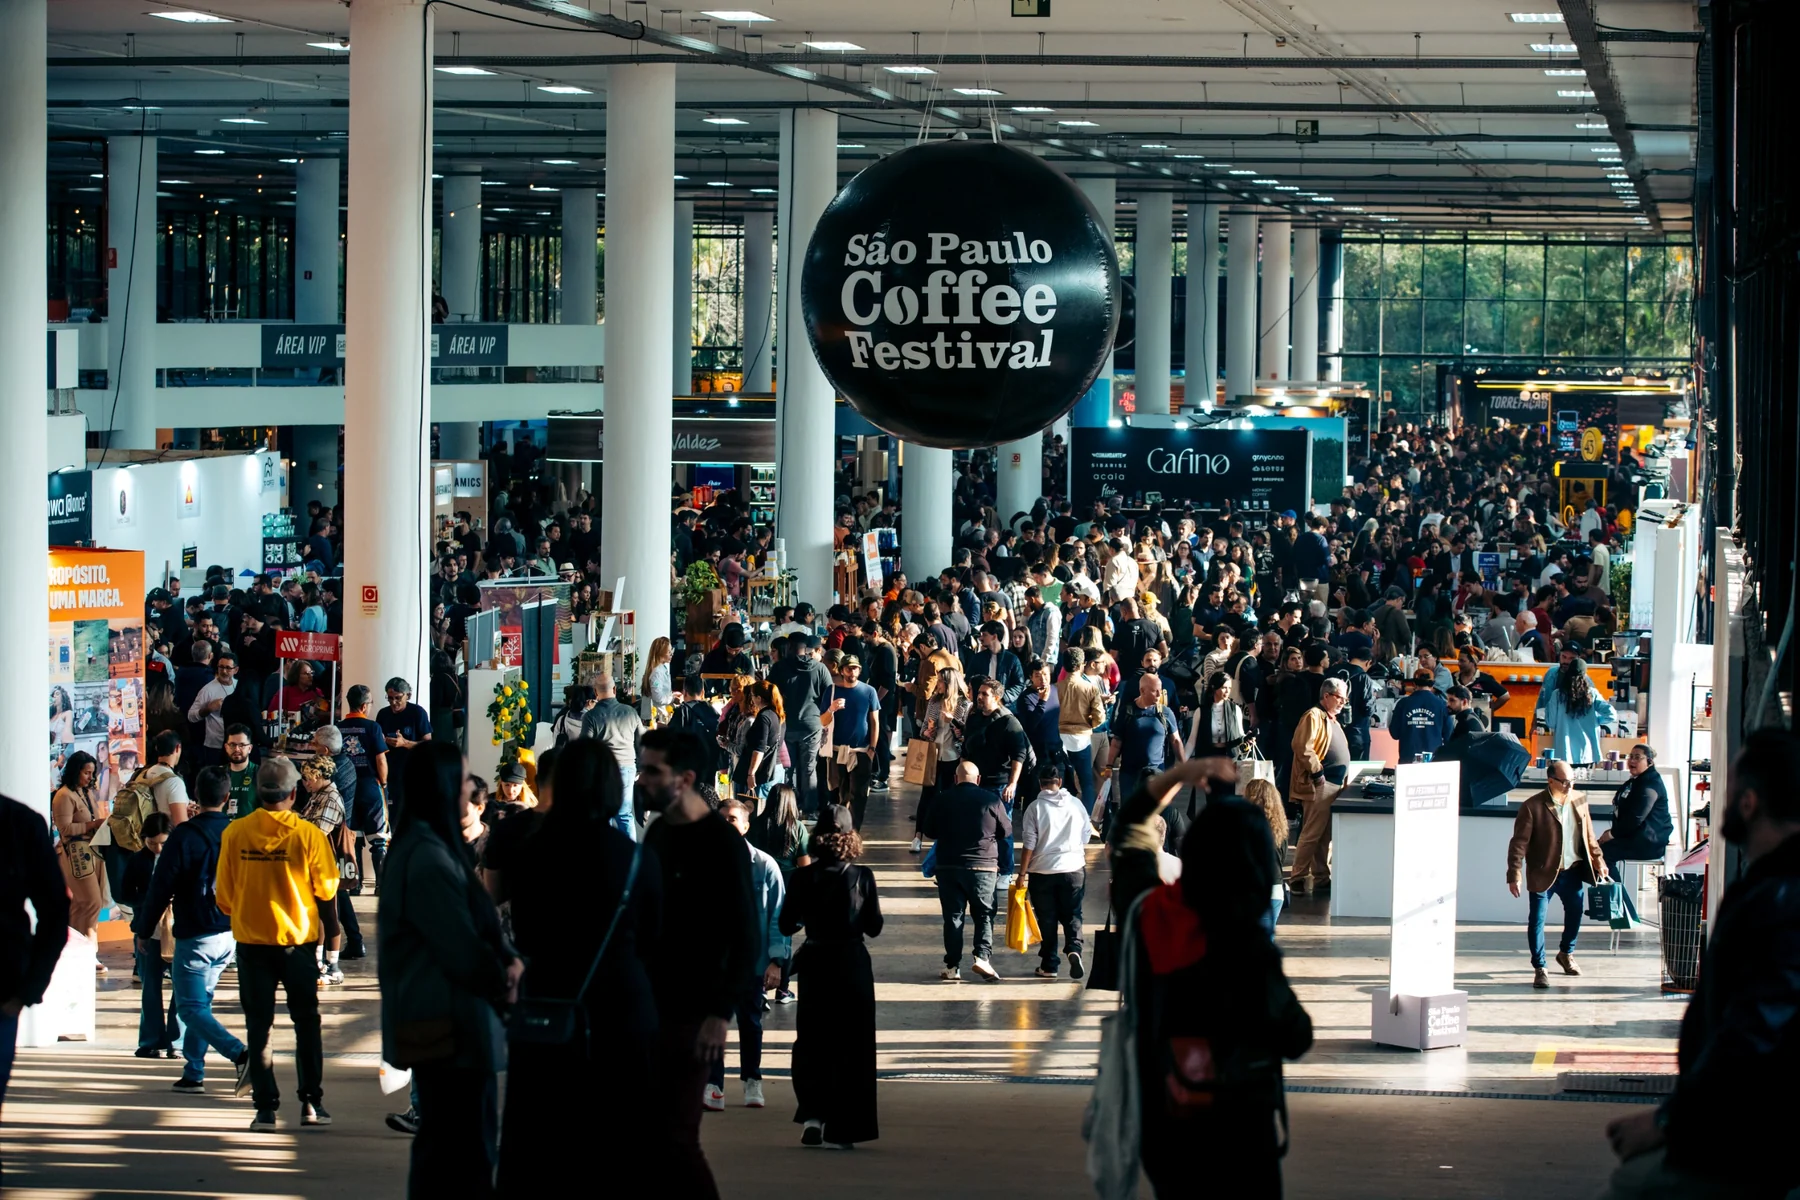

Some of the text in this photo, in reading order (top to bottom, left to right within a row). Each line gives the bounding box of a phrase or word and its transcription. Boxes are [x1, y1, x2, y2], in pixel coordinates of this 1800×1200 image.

[844, 232, 1053, 266] São Paulo
[841, 269, 1057, 326] Coffee
[276, 334, 305, 355] ÁREA
[308, 336, 327, 354] VIP
[449, 334, 476, 355] ÁREA
[478, 336, 497, 354] VIP
[844, 329, 1054, 370] Festival
[50, 588, 124, 610] UMA MARCA.
